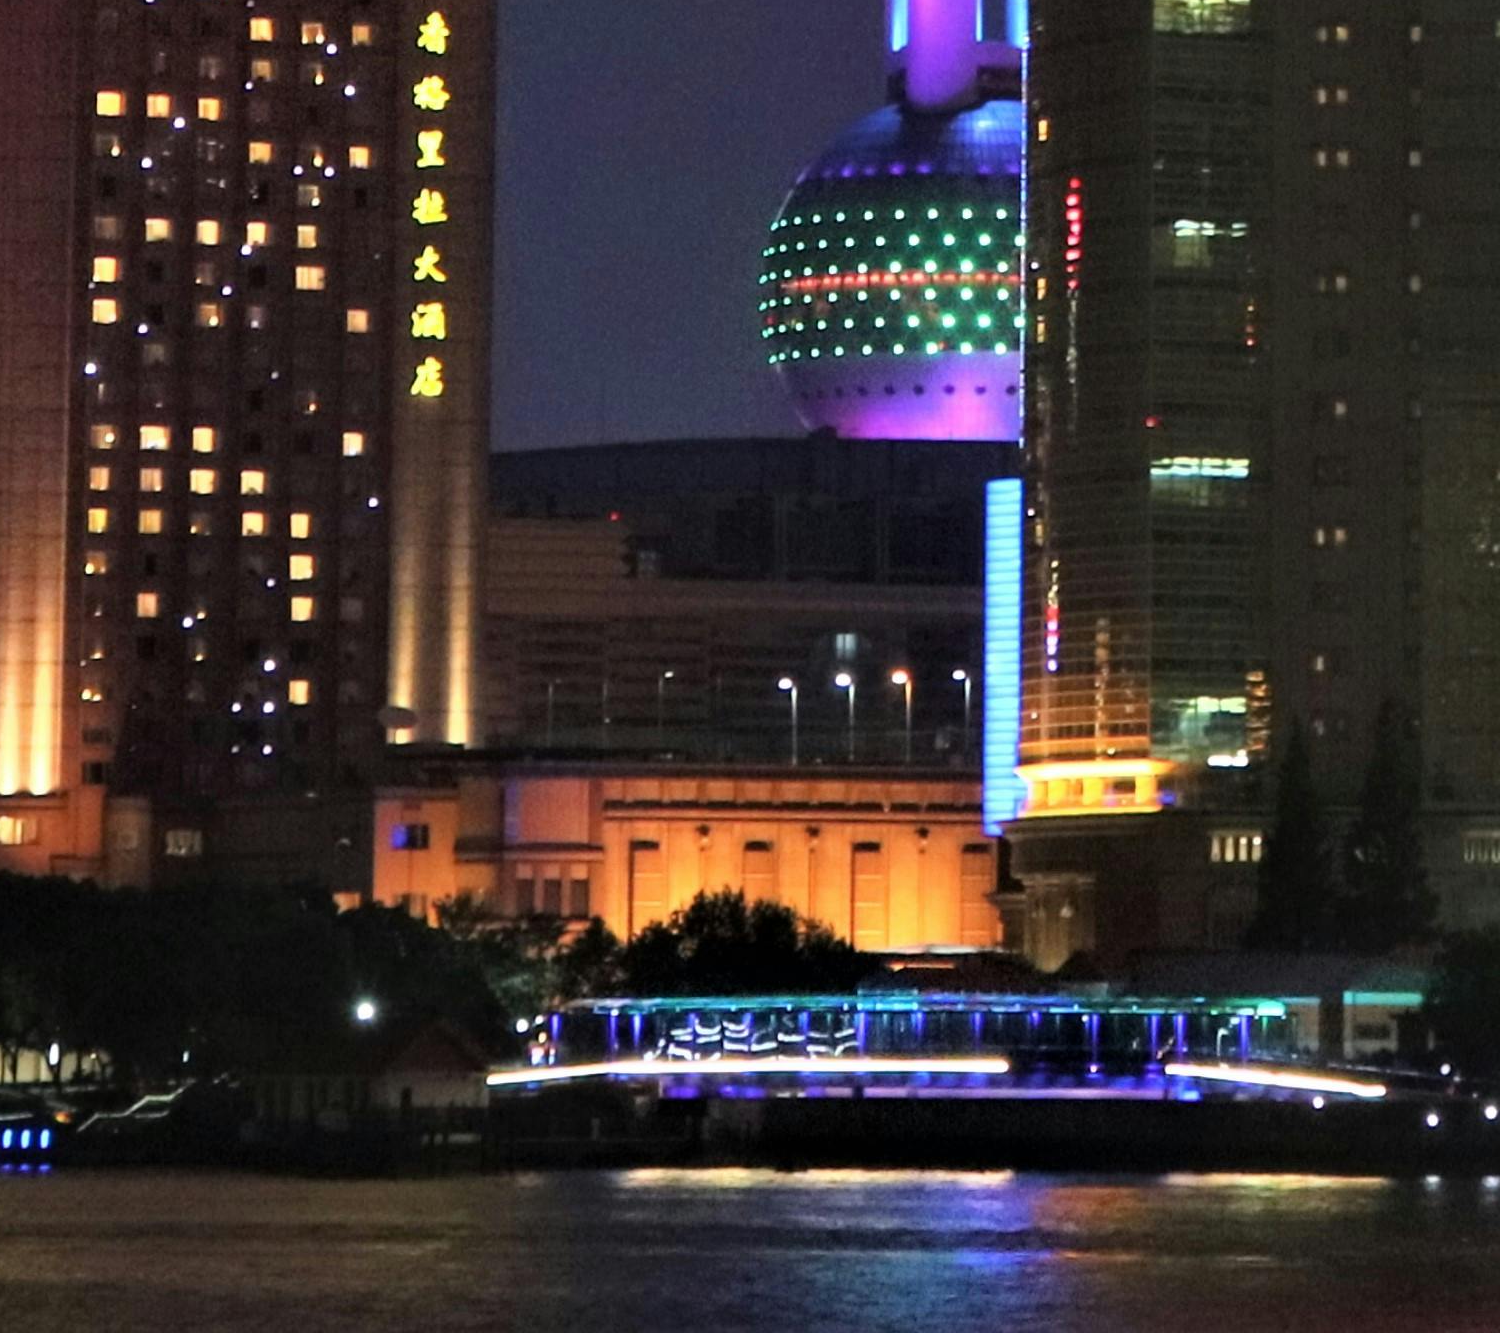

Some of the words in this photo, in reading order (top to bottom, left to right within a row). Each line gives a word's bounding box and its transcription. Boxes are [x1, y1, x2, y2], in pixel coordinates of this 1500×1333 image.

[409, 10, 451, 398] 香格里拉大酒店
